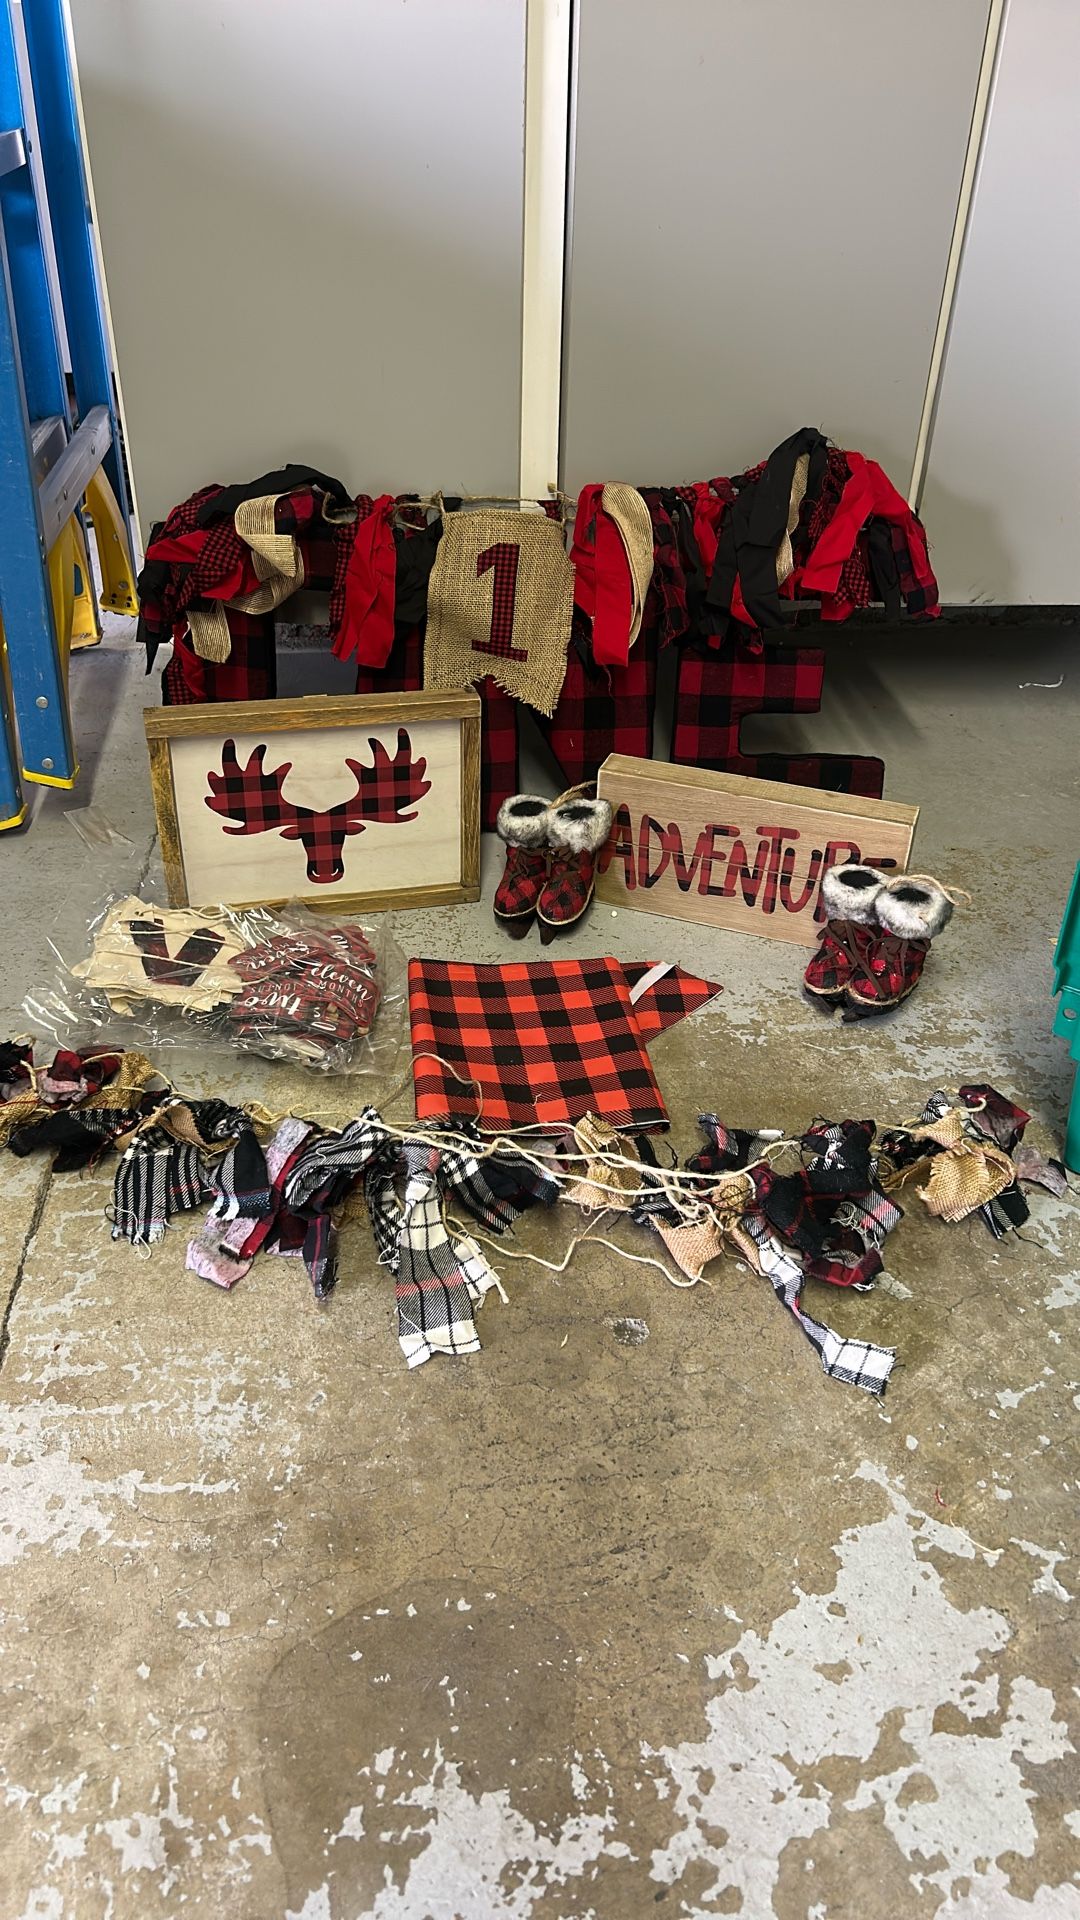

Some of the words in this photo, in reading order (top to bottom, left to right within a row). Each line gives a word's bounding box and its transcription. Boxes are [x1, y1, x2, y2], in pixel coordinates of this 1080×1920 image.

[472, 543, 528, 662] 1
[596, 803, 898, 923] ADVENTUR
[245, 992, 301, 1015] two
[311, 965, 372, 1001] eleven
